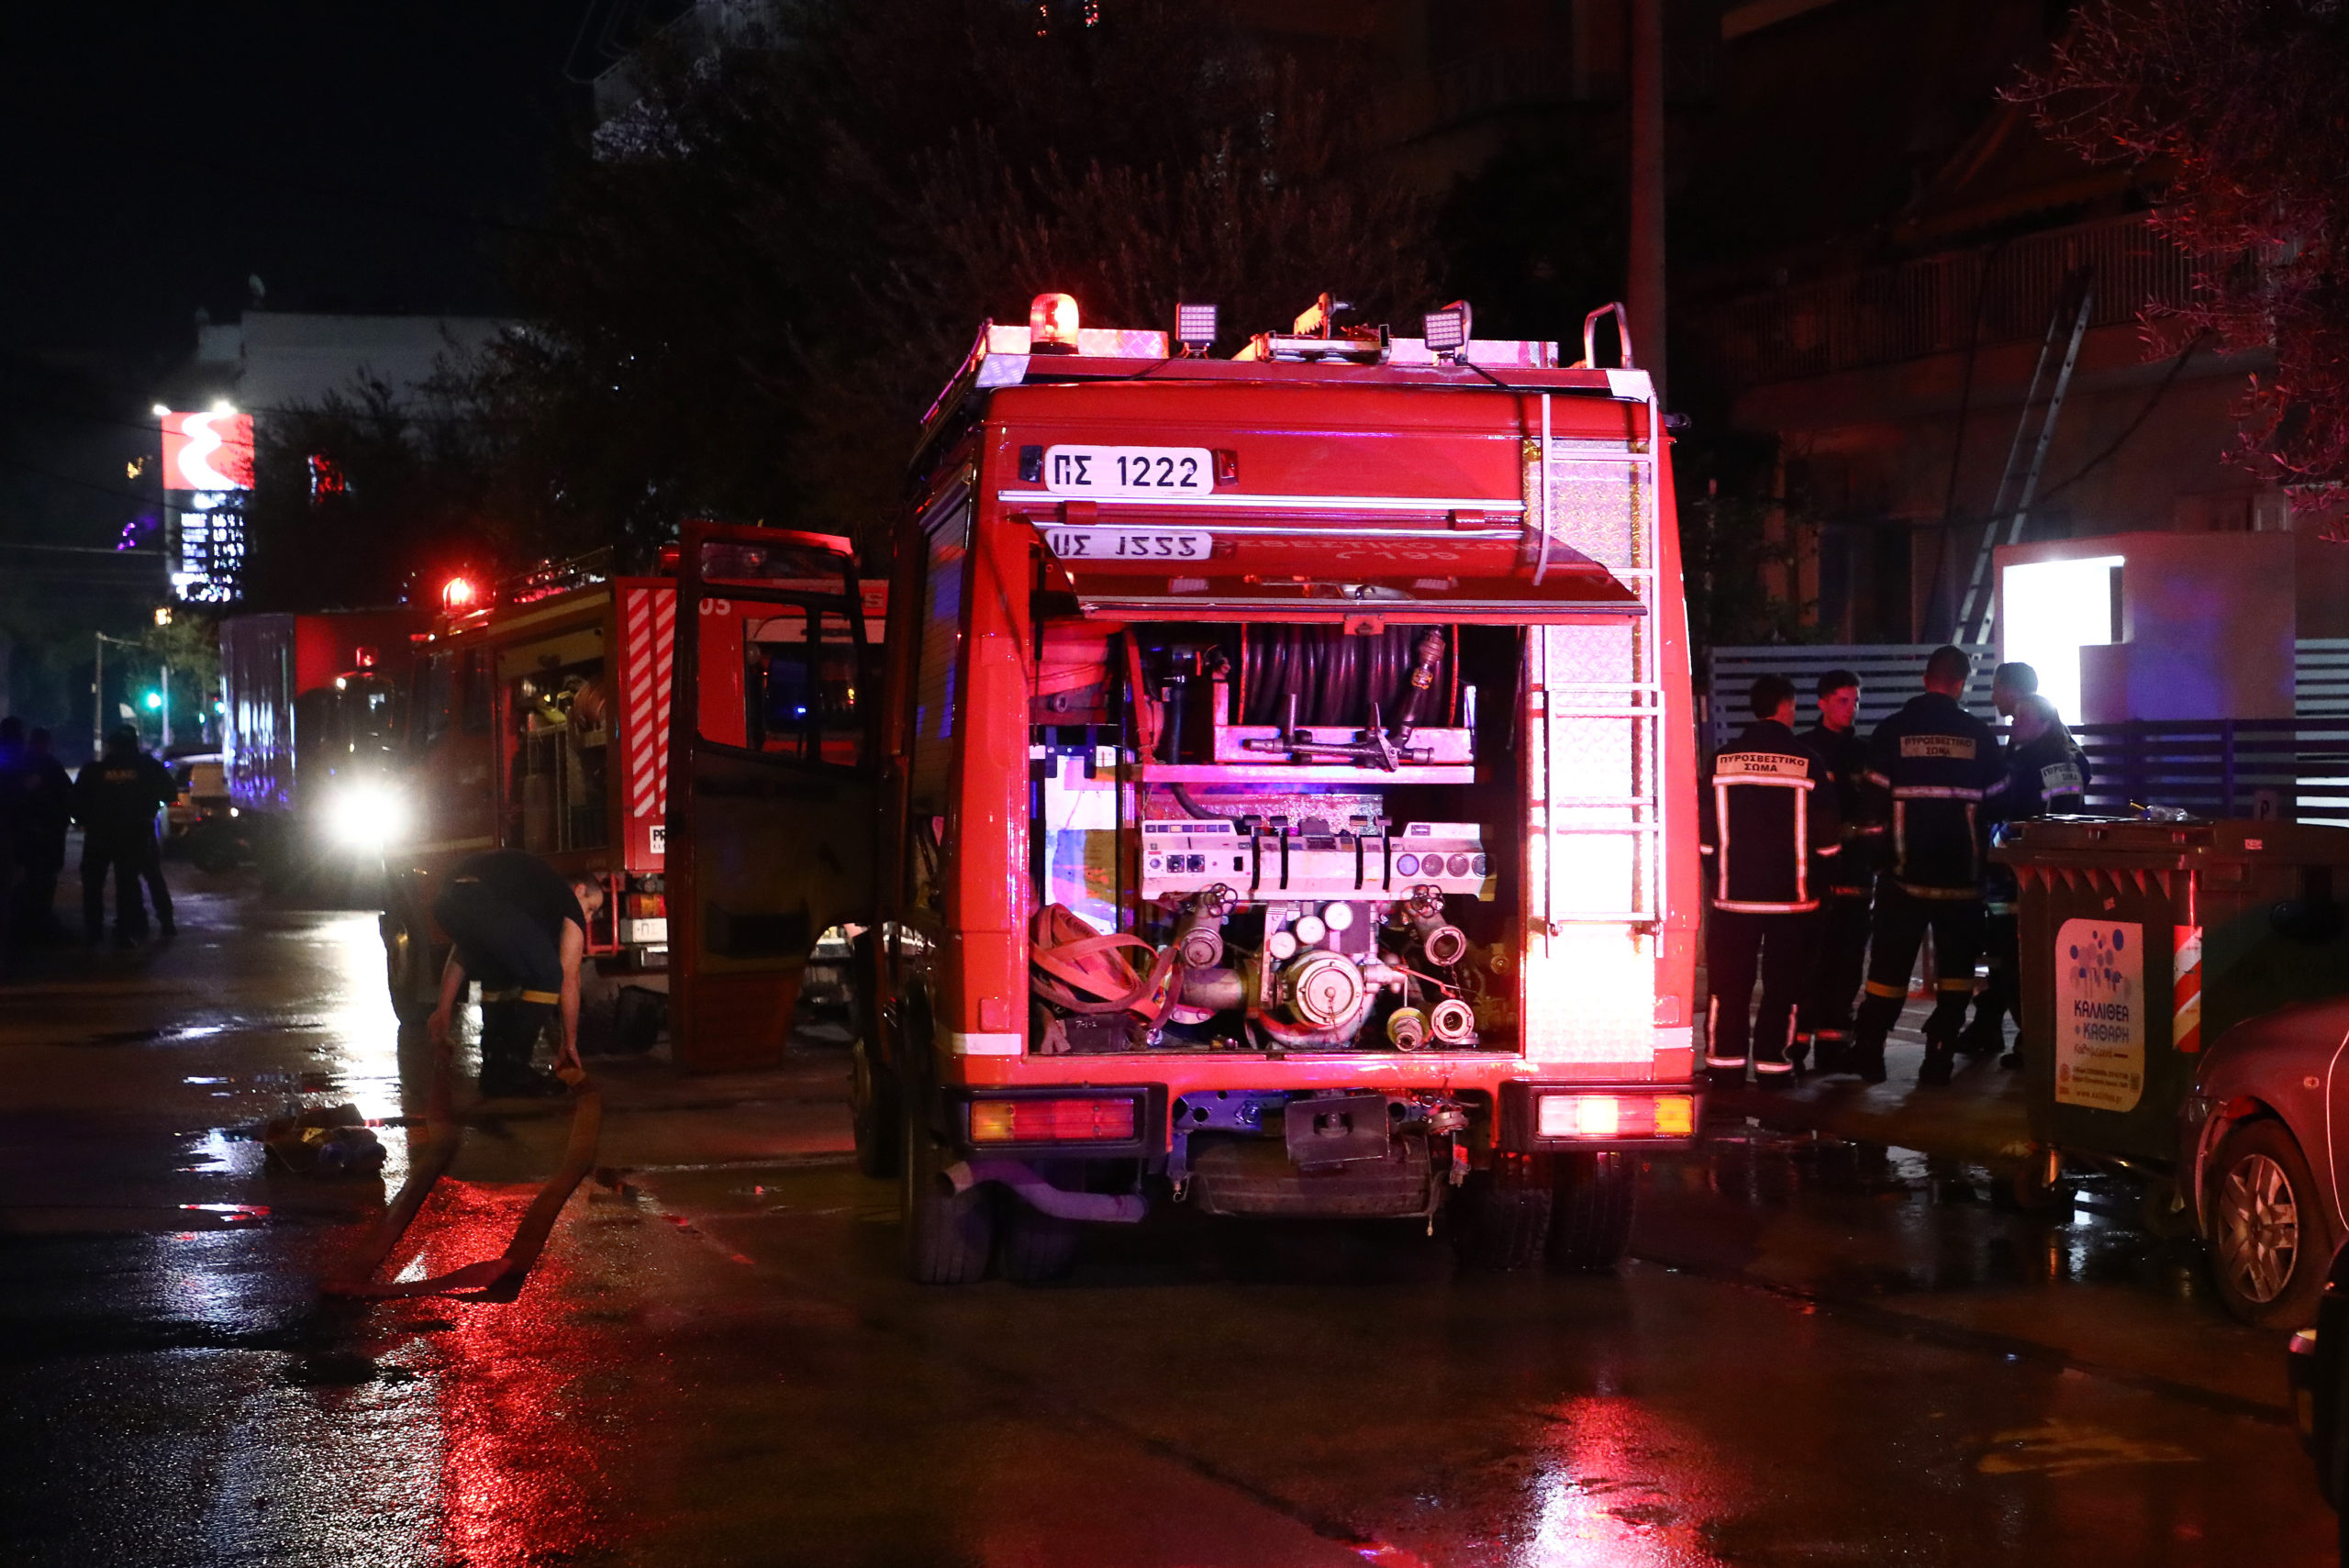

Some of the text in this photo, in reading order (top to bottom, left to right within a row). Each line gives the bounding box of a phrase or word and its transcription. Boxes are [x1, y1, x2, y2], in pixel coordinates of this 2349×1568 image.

[1054, 455, 1198, 487] ΠΣ 1222
[1720, 754, 1806, 767] ΠΥΡΟΣΒΕΣΤΙΚΟ
[1743, 762, 1777, 773] ΣΩΜΑ
[2074, 999, 2130, 1022] ΚΑΛΛΙΘΕΑ
[2083, 1022, 2130, 1044] ΚΑΘΑΡΗ
